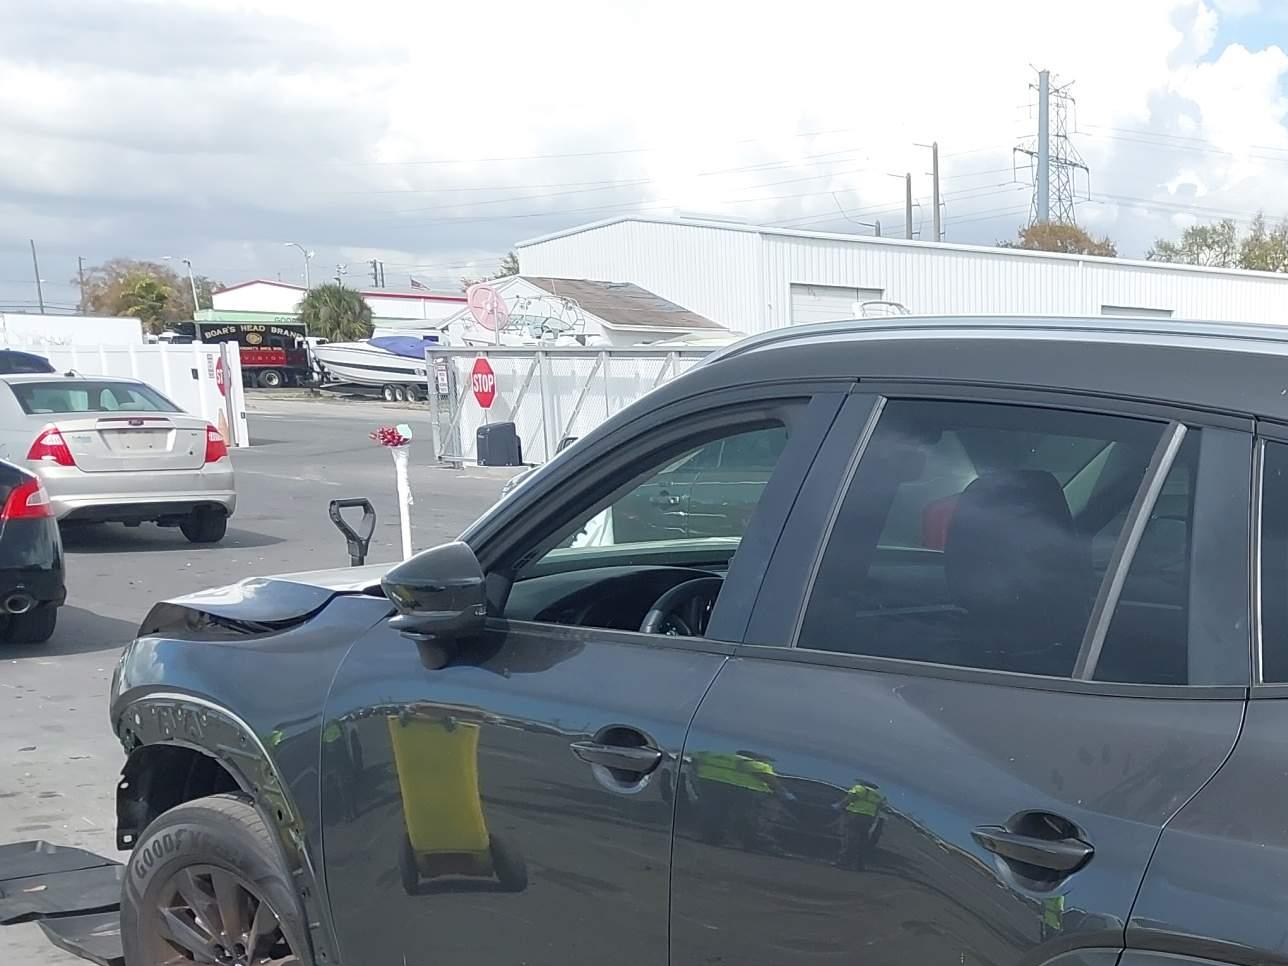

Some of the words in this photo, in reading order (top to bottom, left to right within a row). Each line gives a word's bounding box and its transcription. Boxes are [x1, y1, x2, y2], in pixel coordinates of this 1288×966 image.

[205, 325, 236, 339] BOAR'S
[271, 326, 304, 341] BRAND
[474, 374, 494, 393] STOP
